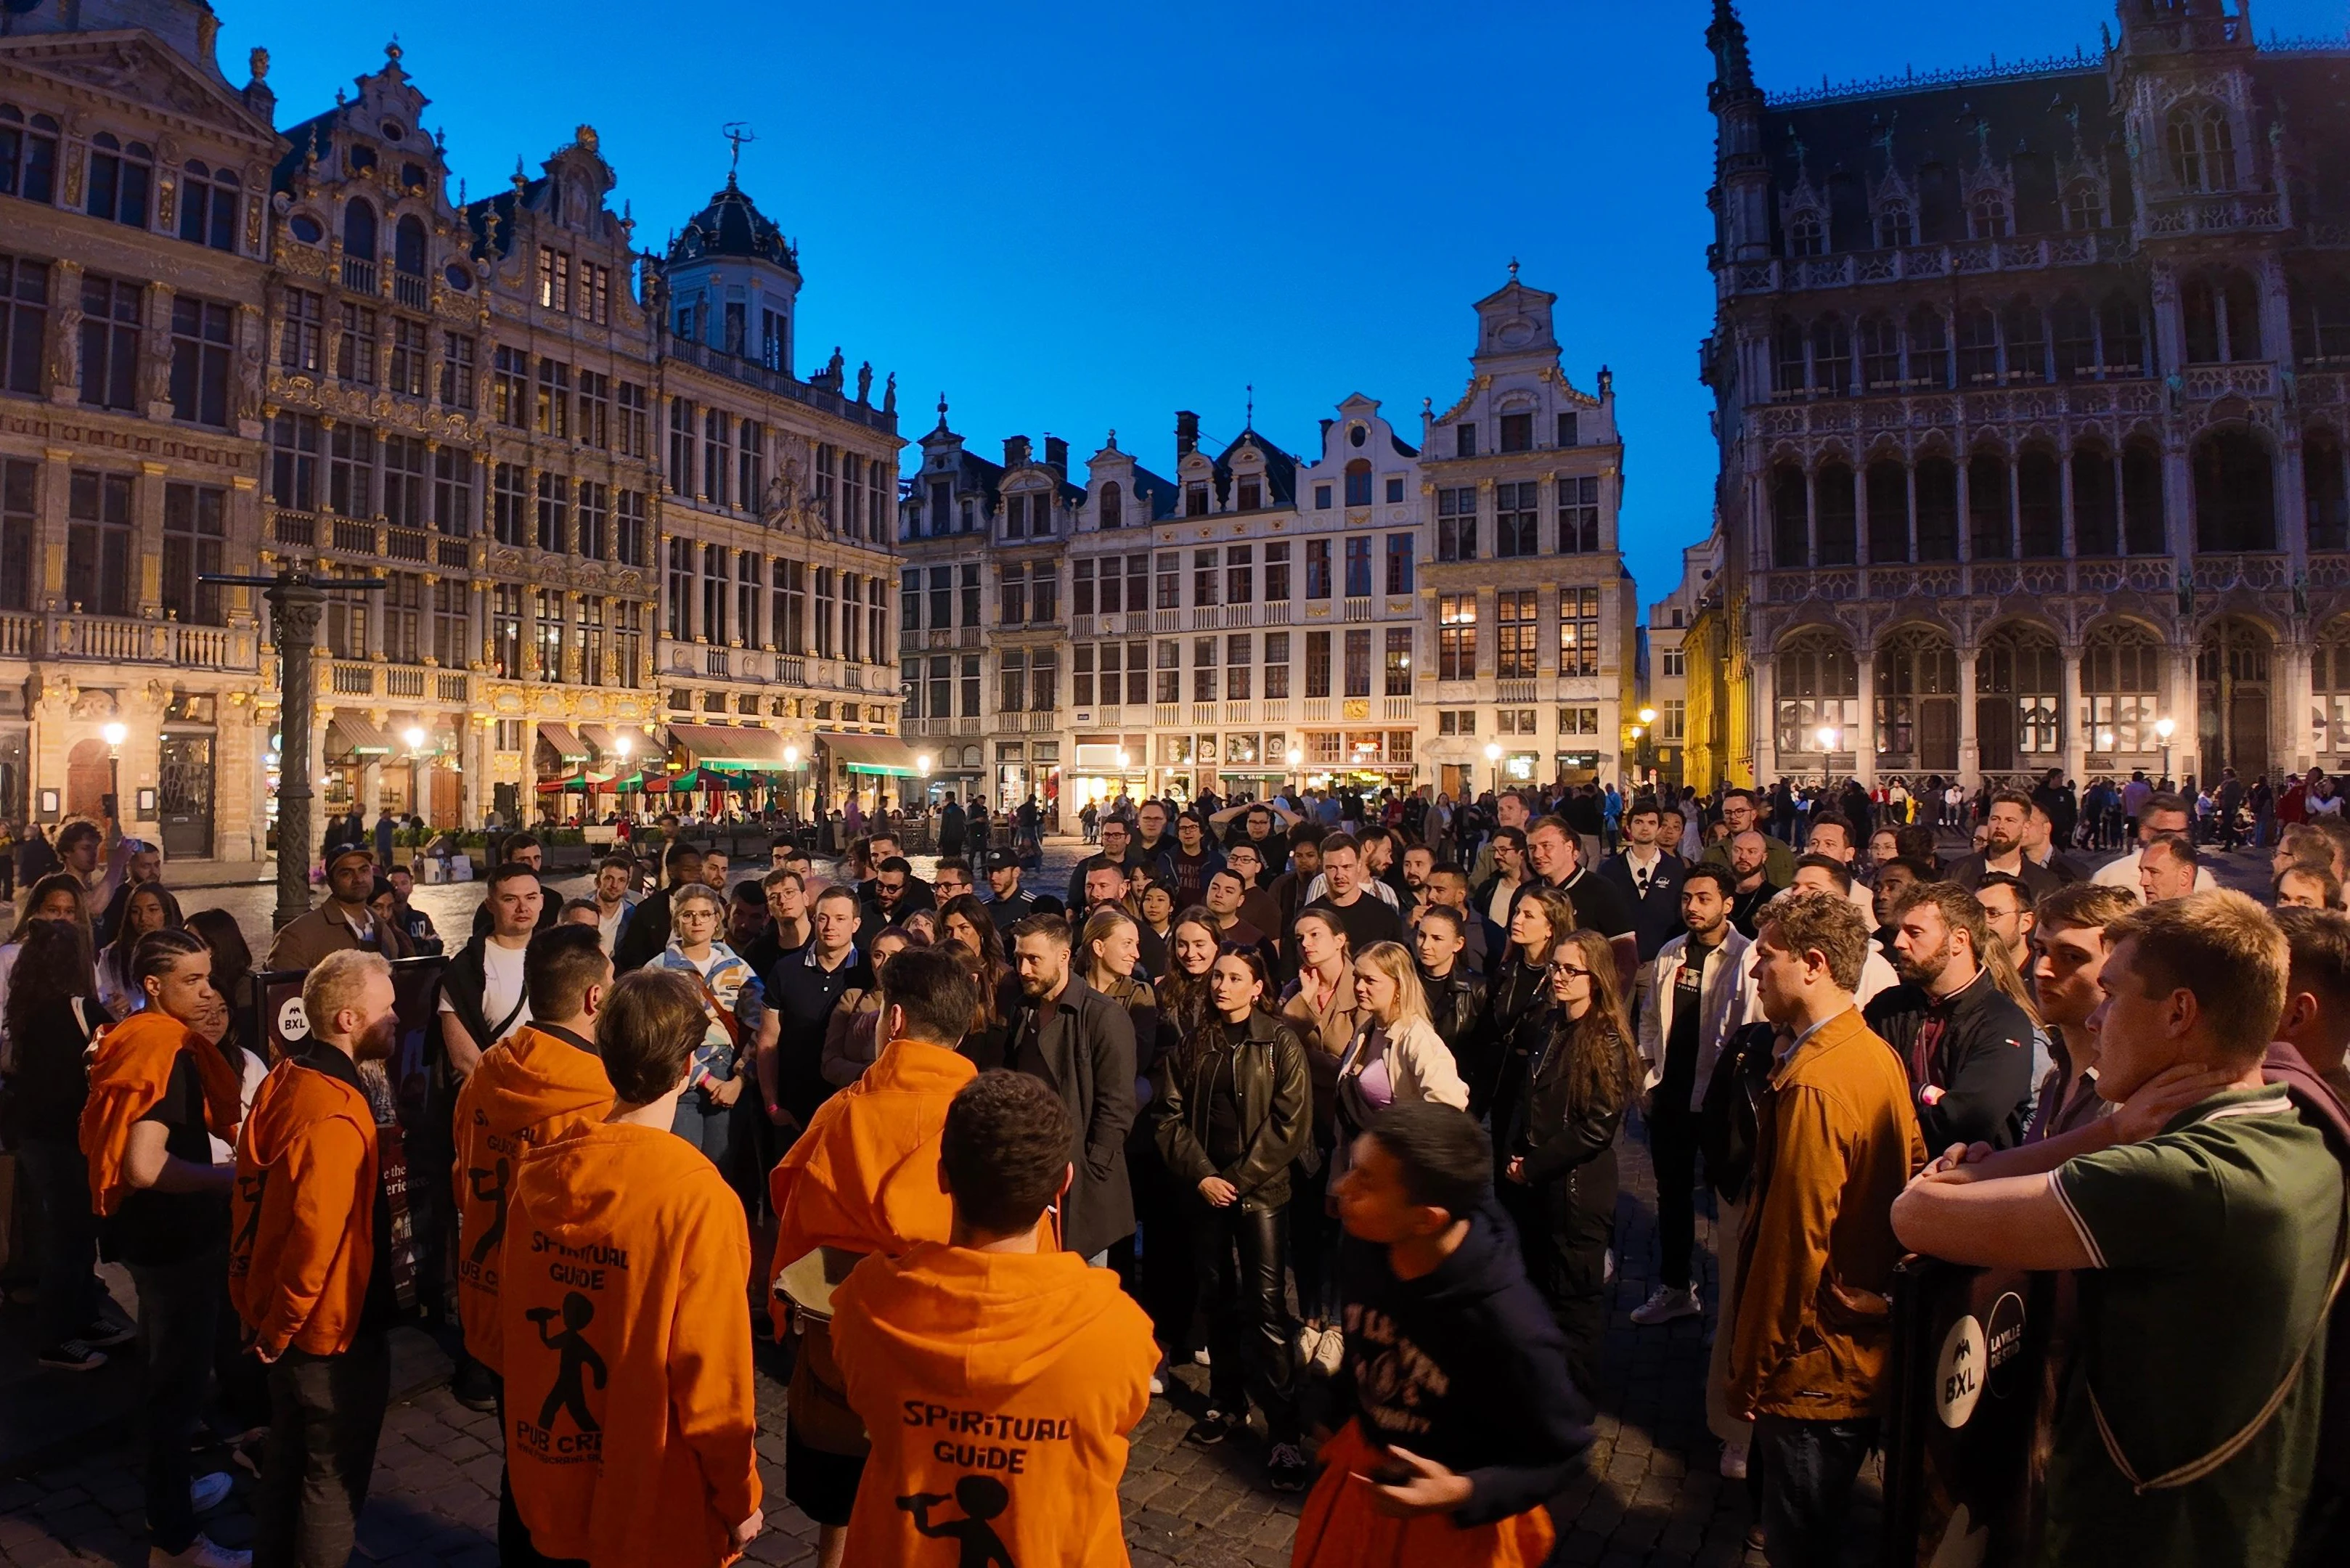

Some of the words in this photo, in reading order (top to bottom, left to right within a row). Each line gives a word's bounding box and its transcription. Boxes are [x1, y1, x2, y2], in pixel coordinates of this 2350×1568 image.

[285, 1018, 306, 1030] BXL
[391, 1164, 406, 1177] the
[1991, 1336, 2001, 1352] LA
[2000, 1324, 2021, 1347] VILLE
[1945, 1368, 1975, 1405] BXL
[517, 1420, 550, 1453] PUB
